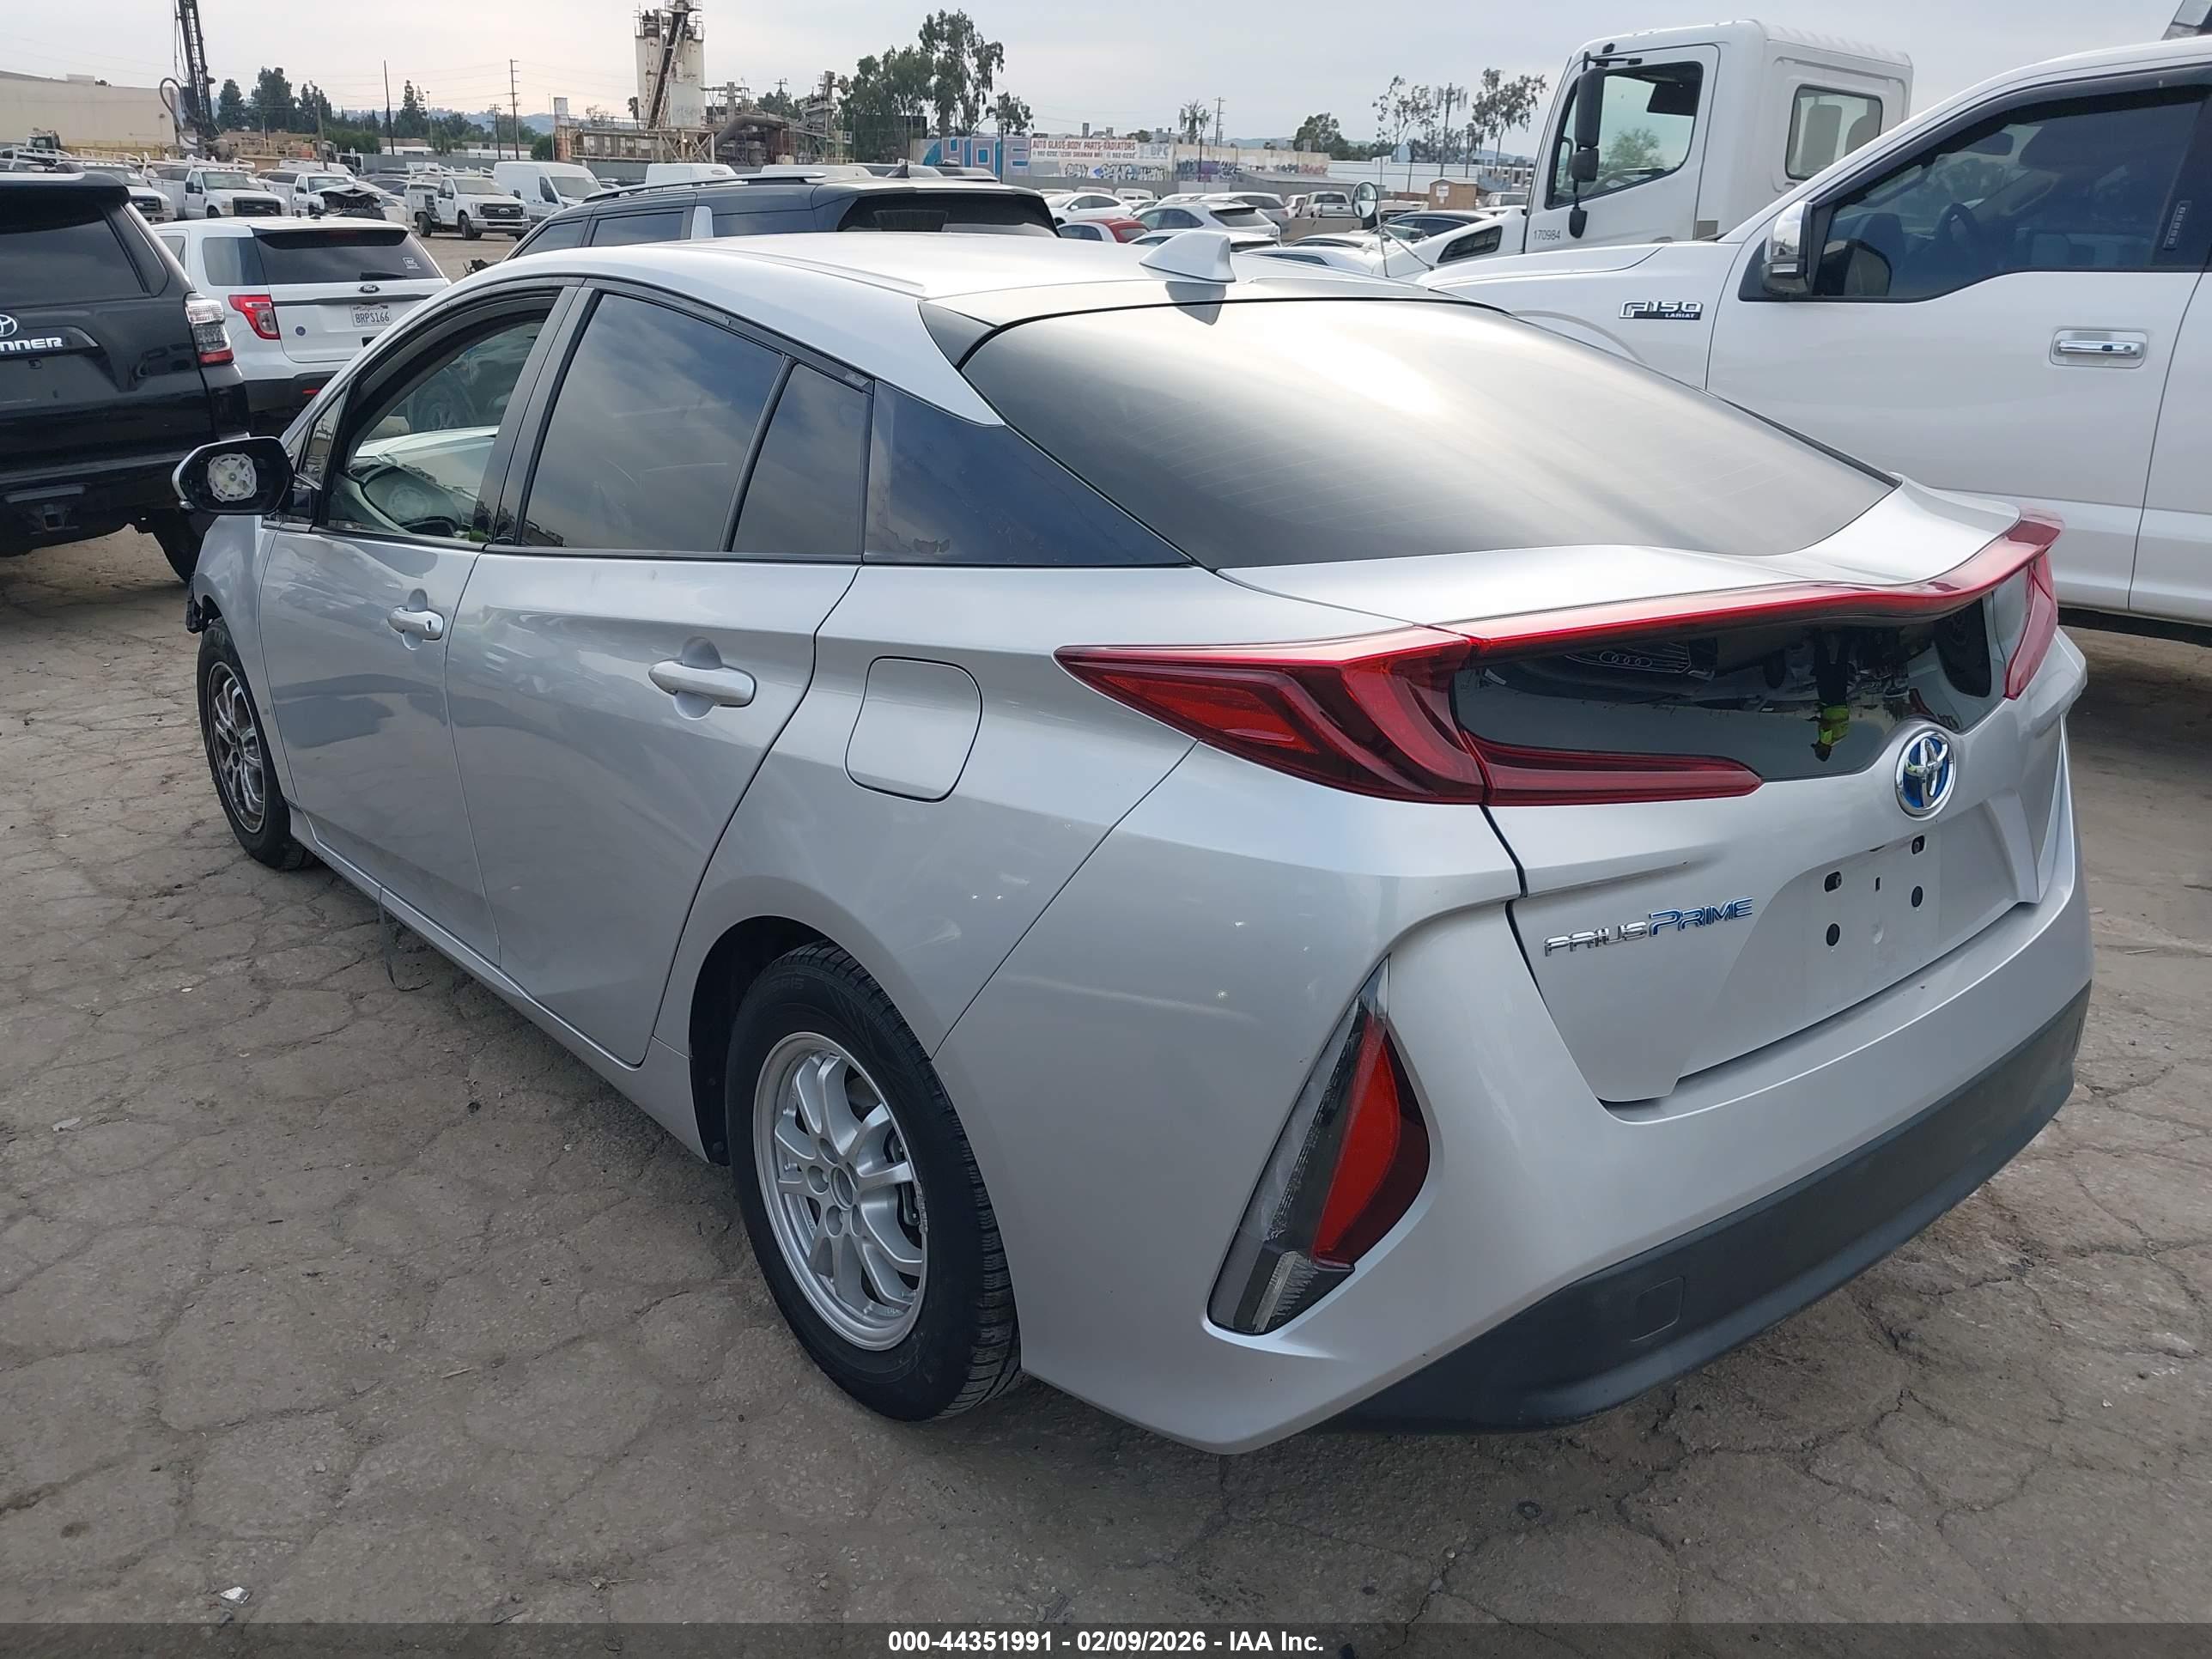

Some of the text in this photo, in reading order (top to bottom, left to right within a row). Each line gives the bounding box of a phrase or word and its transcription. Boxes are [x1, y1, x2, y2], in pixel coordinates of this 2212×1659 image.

[1032, 140, 1047, 149] AUTO
[1533, 229, 1560, 240] 170984
[1647, 896, 1753, 938] PRIME
